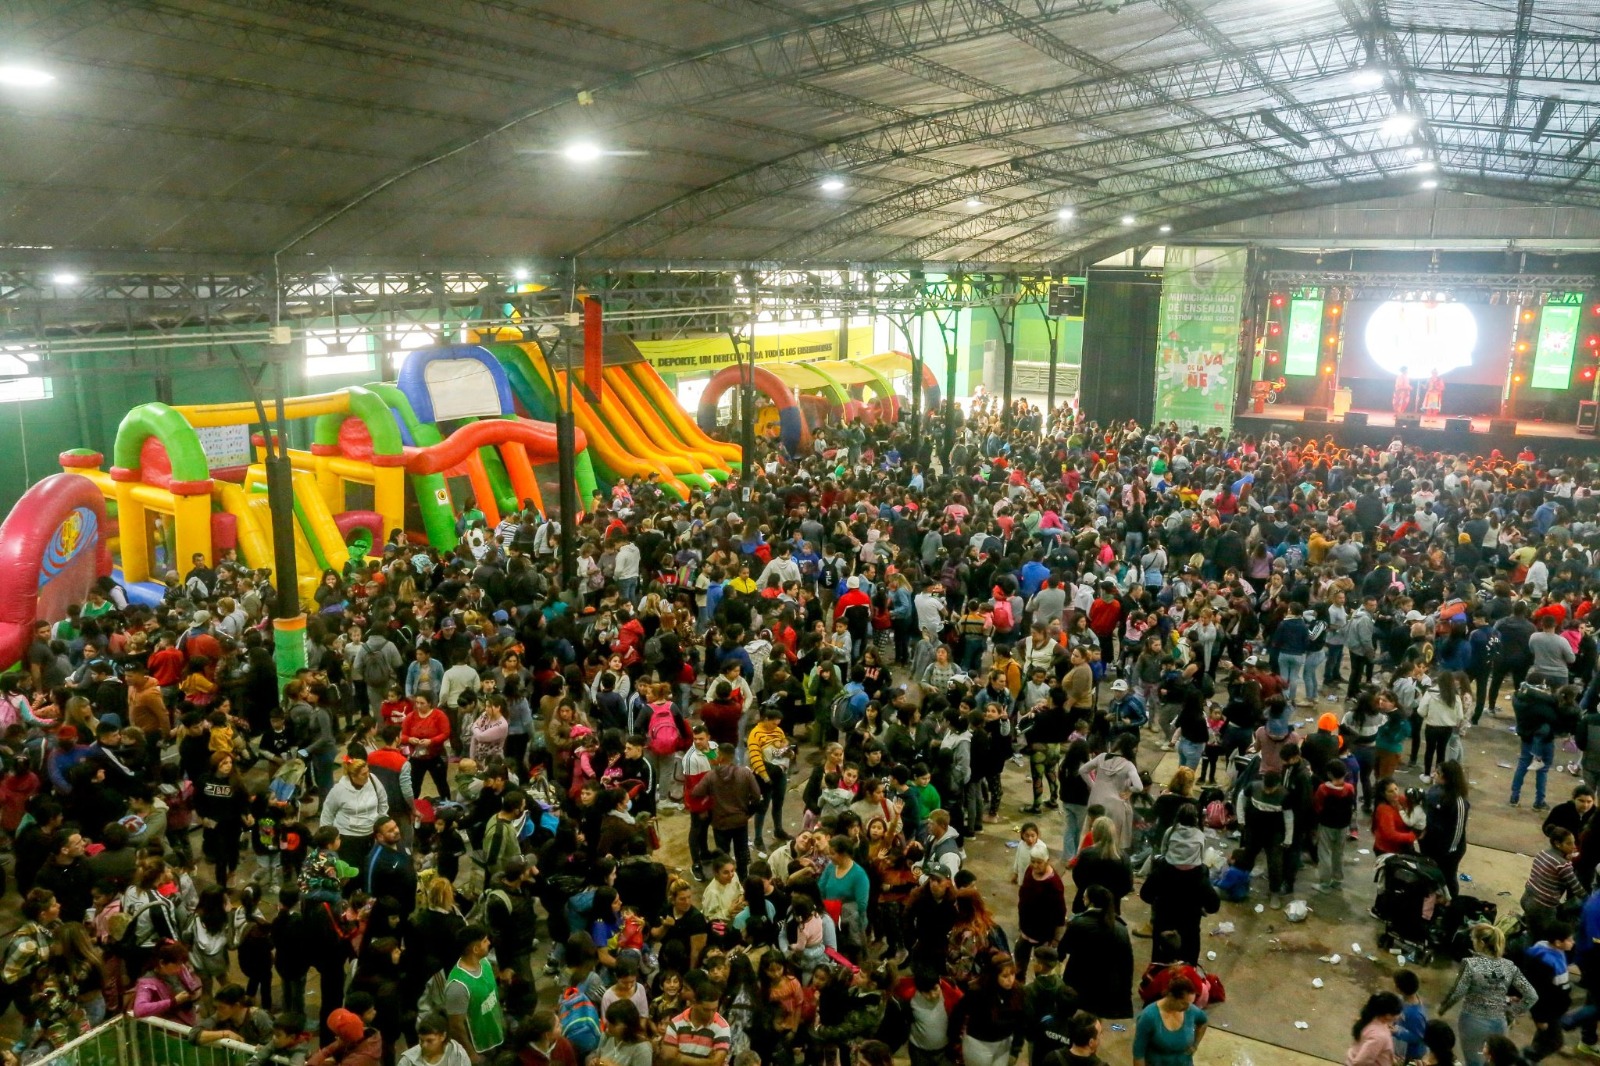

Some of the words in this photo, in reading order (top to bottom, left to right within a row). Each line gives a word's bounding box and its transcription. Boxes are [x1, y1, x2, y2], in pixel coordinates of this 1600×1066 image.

[1168, 292, 1237, 303] MUNICIPALIDAD
[1167, 303, 1181, 312] DE
[1183, 303, 1235, 314] ENSENADA
[658, 356, 698, 367] DEPORTE,
[699, 355, 712, 364] UN
[746, 350, 764, 360] PRA
[764, 348, 785, 359] TODOS
[785, 347, 797, 356] LOS
